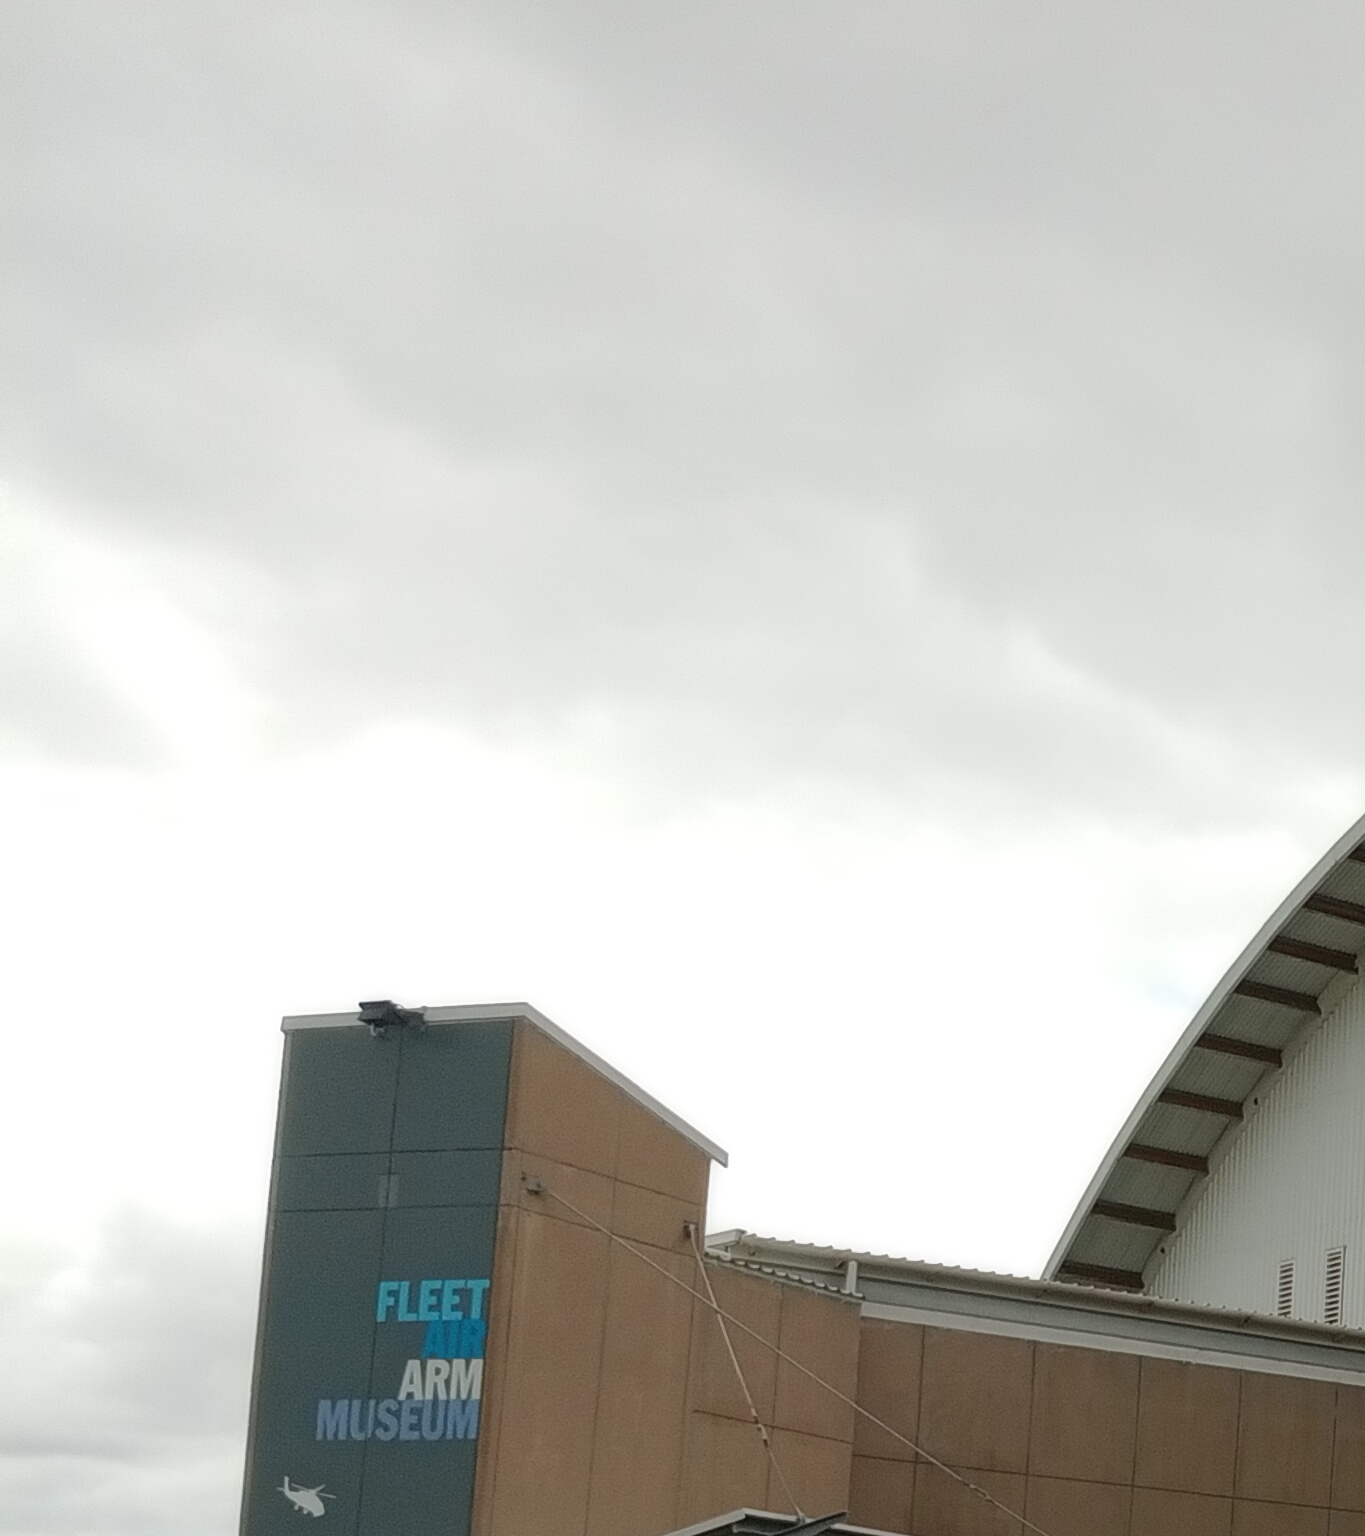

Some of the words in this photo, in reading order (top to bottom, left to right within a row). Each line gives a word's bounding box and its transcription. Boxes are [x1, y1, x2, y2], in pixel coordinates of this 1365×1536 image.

[376, 1279, 490, 1323] FLEET
[421, 1319, 486, 1359] AIR
[398, 1359, 483, 1401] ARM
[315, 1398, 480, 1441] MUSEUM
